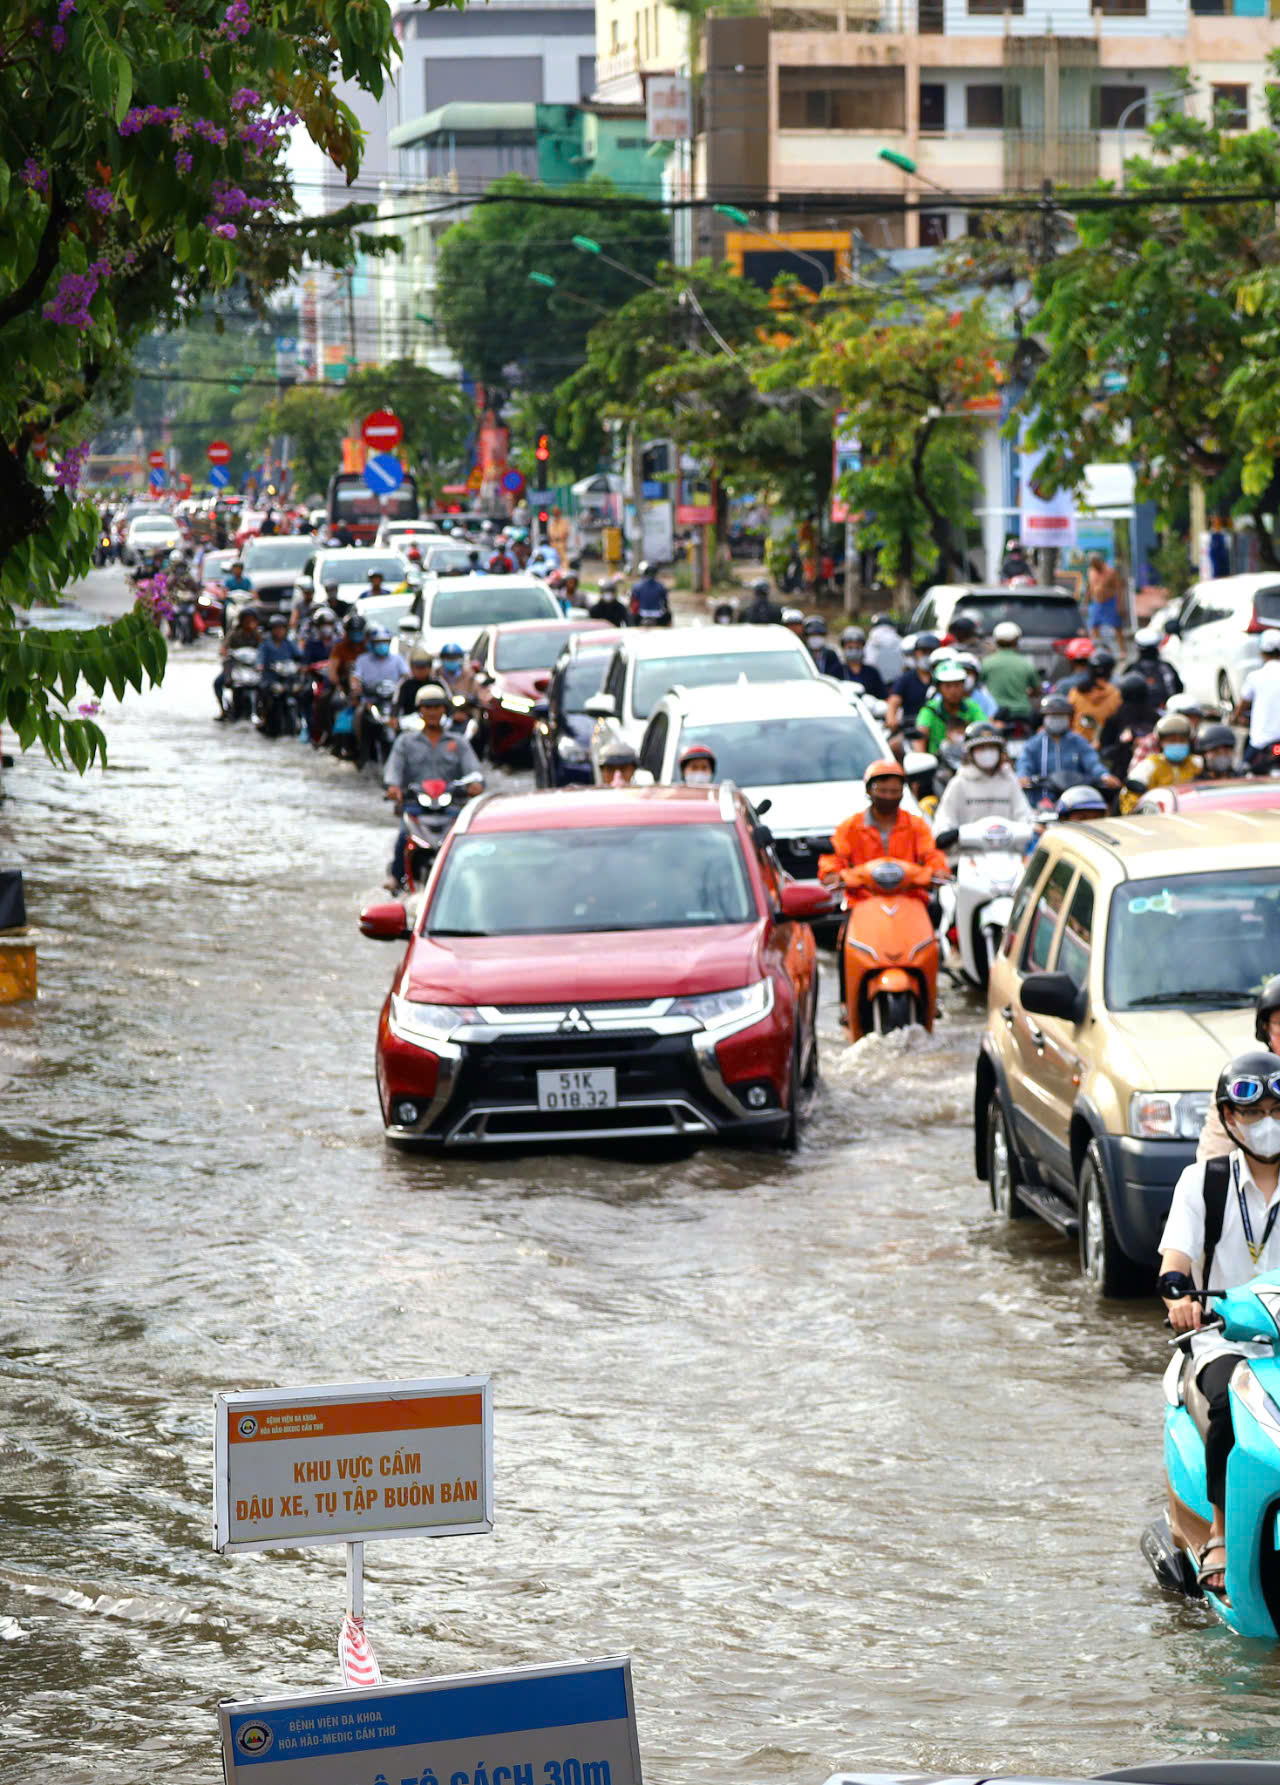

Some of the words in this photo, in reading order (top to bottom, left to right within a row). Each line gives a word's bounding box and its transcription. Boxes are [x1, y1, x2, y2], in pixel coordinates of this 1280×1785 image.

[560, 1072, 592, 1090] 51K
[293, 1459, 331, 1484] KHU
[337, 1456, 373, 1483] VỰC
[380, 1447, 421, 1476] CẤM
[236, 1495, 273, 1524] ĐẬU
[279, 1495, 309, 1518] XE,
[315, 1491, 337, 1517] TỤ
[343, 1486, 378, 1515] TẬP
[384, 1482, 434, 1508] BUÔN
[440, 1477, 478, 1502] BÁN
[289, 1720, 315, 1732] BỆNH
[317, 1715, 339, 1729] VIỆN
[357, 1711, 382, 1724] KHOA
[300, 1730, 353, 1748] HẢO-MEDIC
[356, 1727, 376, 1741] CẦN
[378, 1724, 396, 1738] THƠ
